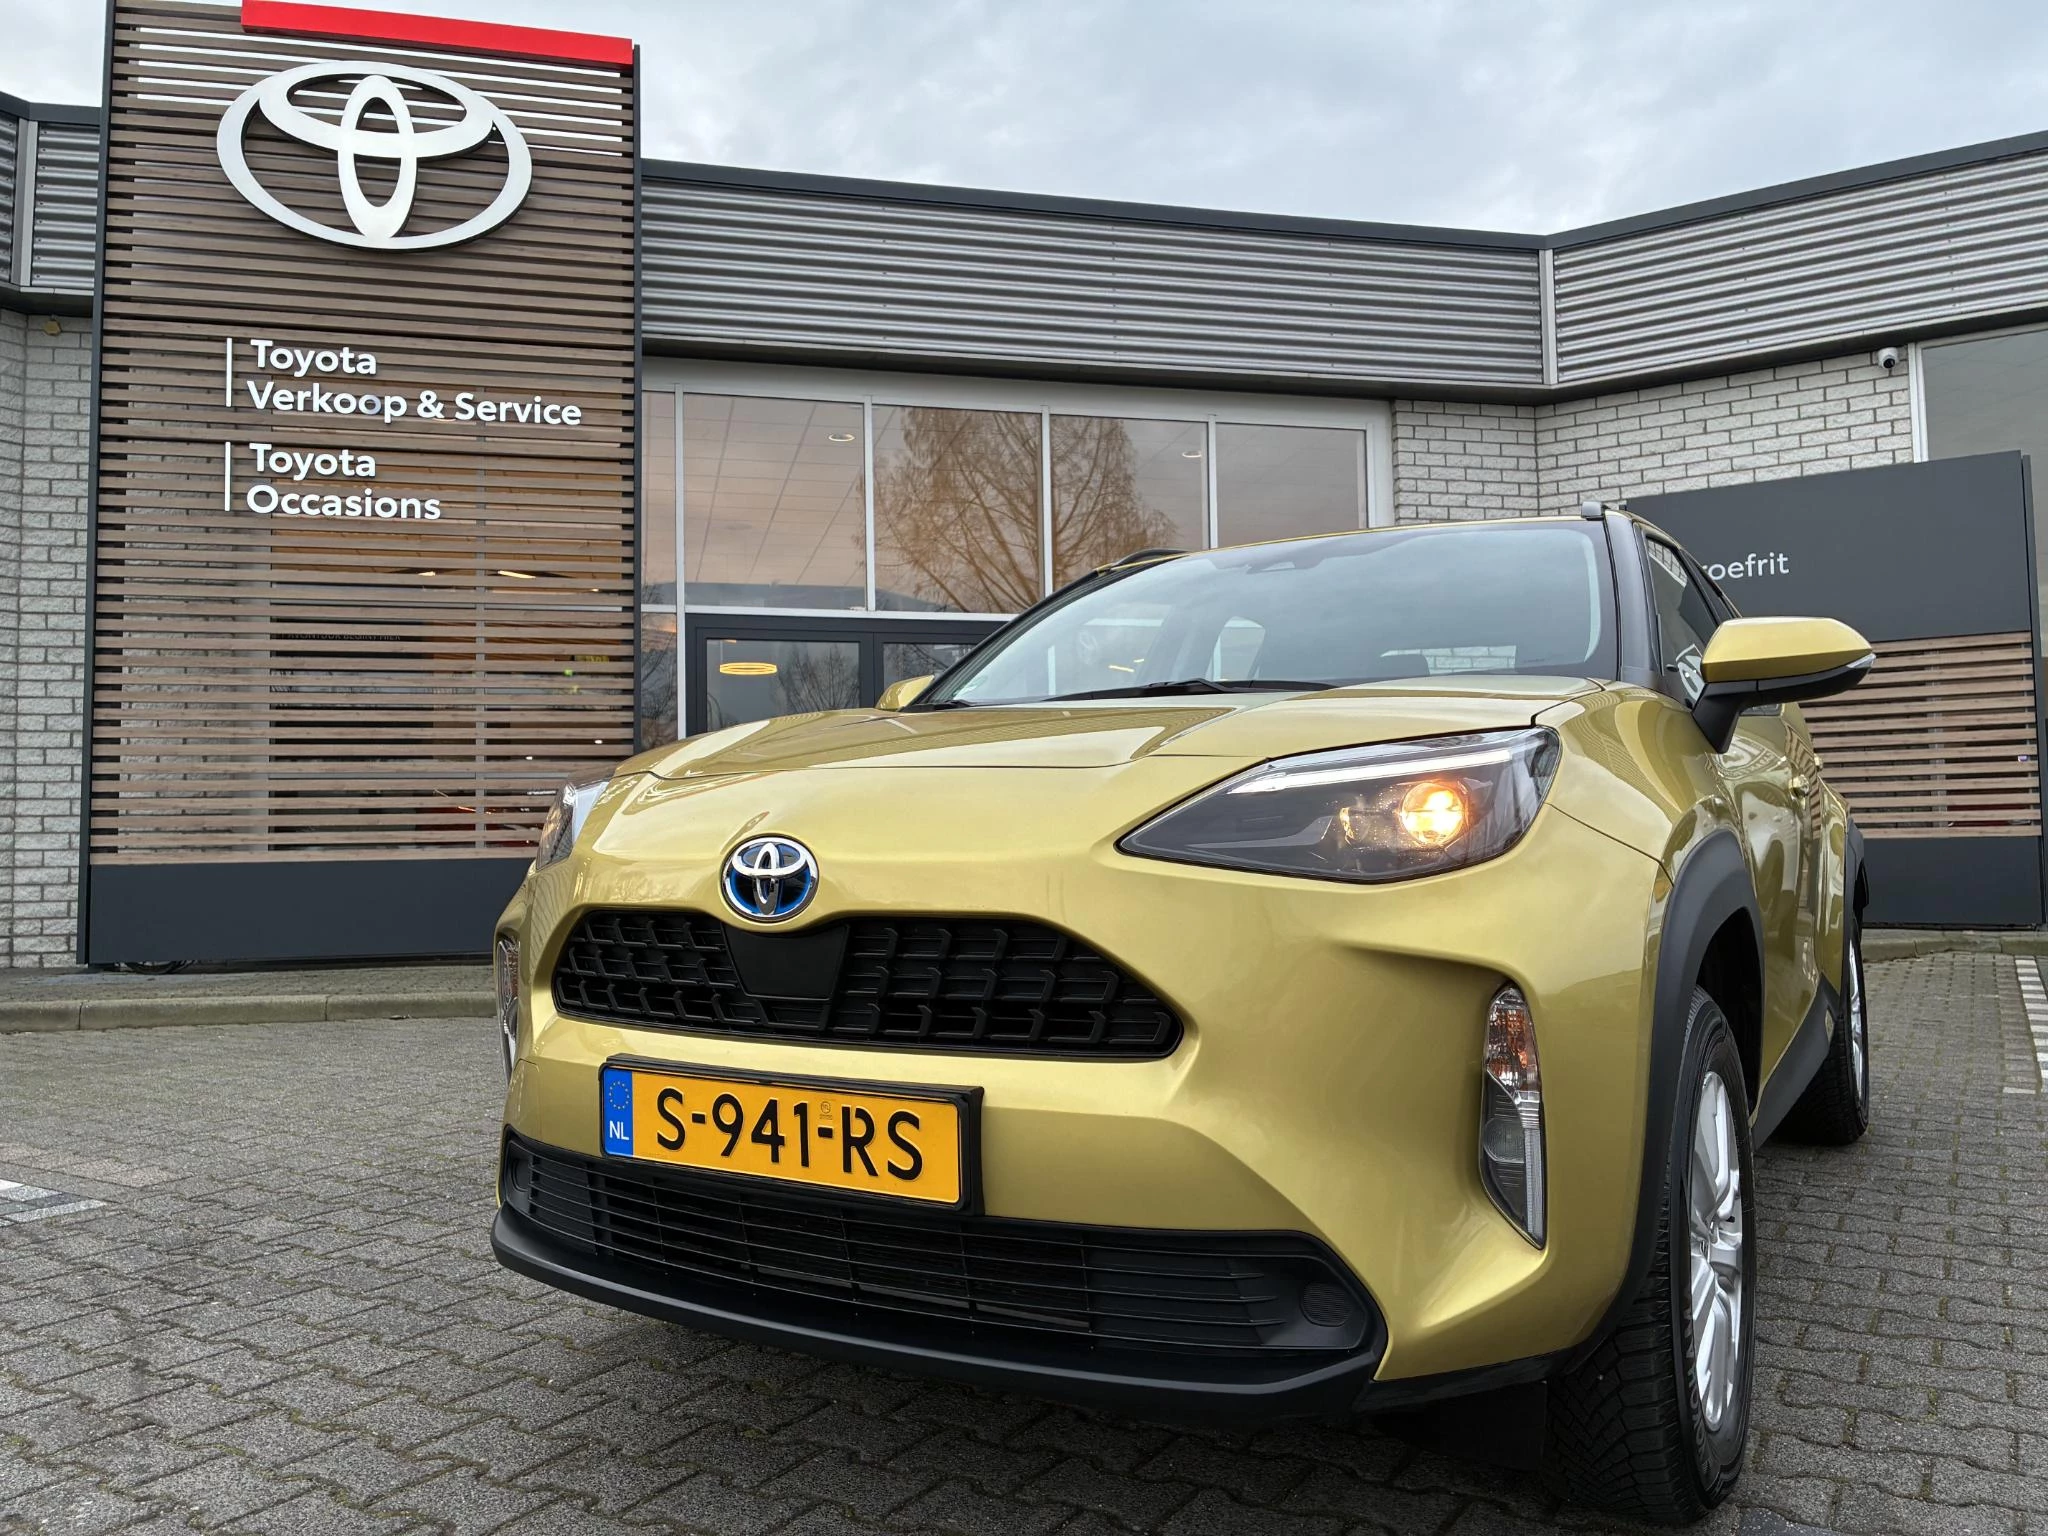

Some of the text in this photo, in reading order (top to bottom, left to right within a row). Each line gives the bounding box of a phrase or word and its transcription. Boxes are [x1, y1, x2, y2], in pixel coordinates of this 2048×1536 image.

[250, 339, 377, 377] Toyota
[246, 380, 582, 425] Verkoop & Service
[248, 443, 376, 481] Toyota
[246, 484, 441, 520] Occasions
[609, 1119, 630, 1142] NL
[656, 1086, 924, 1182] S-941-RS
